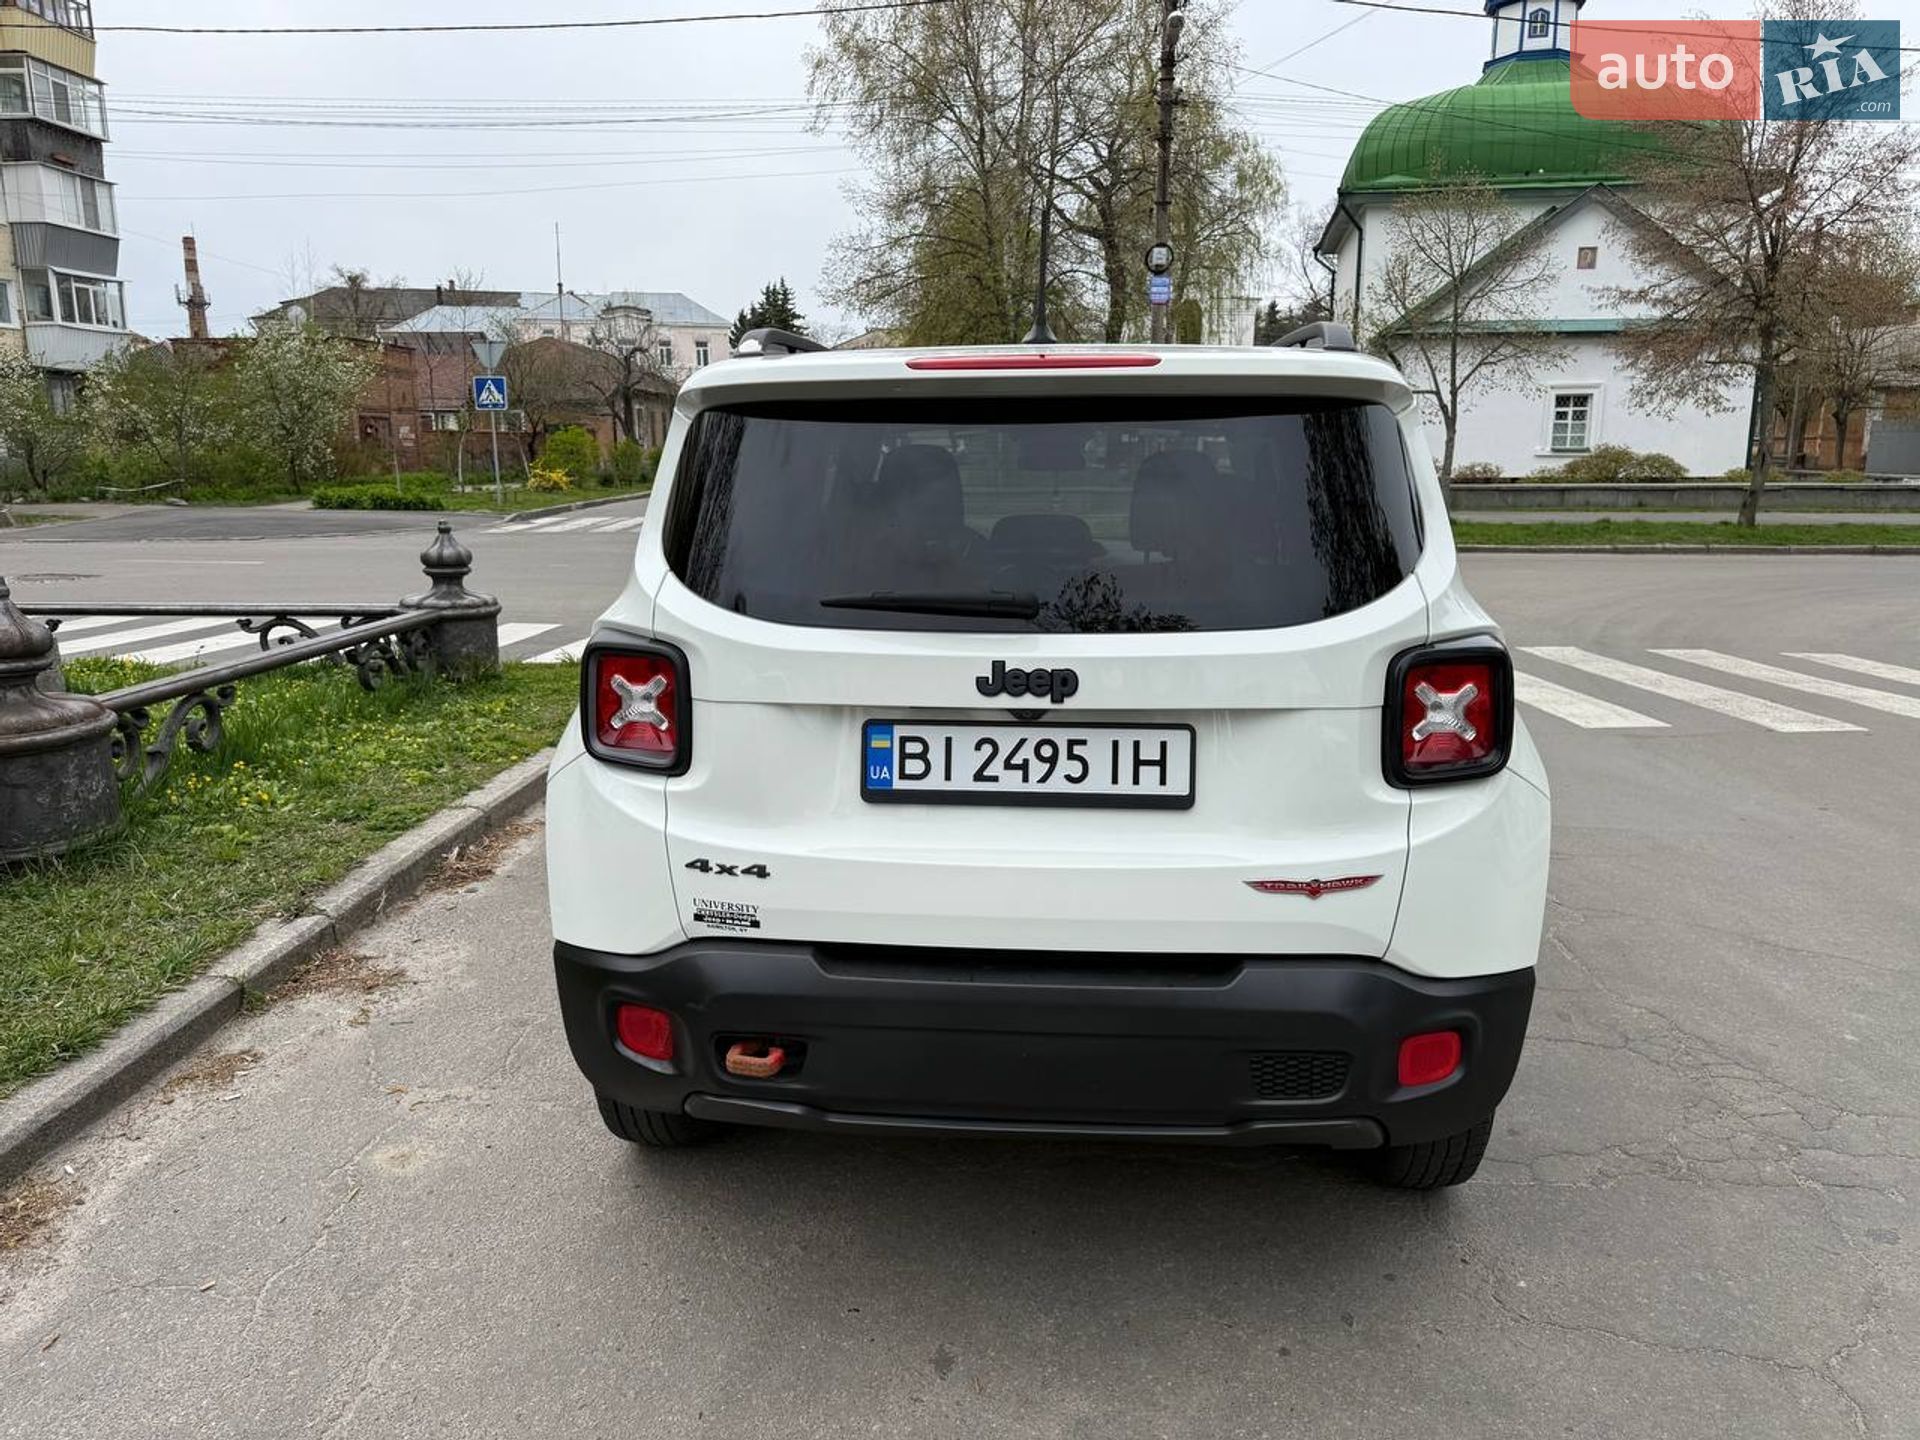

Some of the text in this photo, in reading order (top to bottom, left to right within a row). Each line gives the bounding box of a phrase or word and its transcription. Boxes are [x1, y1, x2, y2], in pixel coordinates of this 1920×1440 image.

[976, 660, 1079, 704] Jeep
[899, 735, 1167, 786] BI 2495 IH
[870, 765, 890, 780] UA
[684, 858, 771, 879] 4x4
[693, 898, 759, 914] UNIVERSITY
